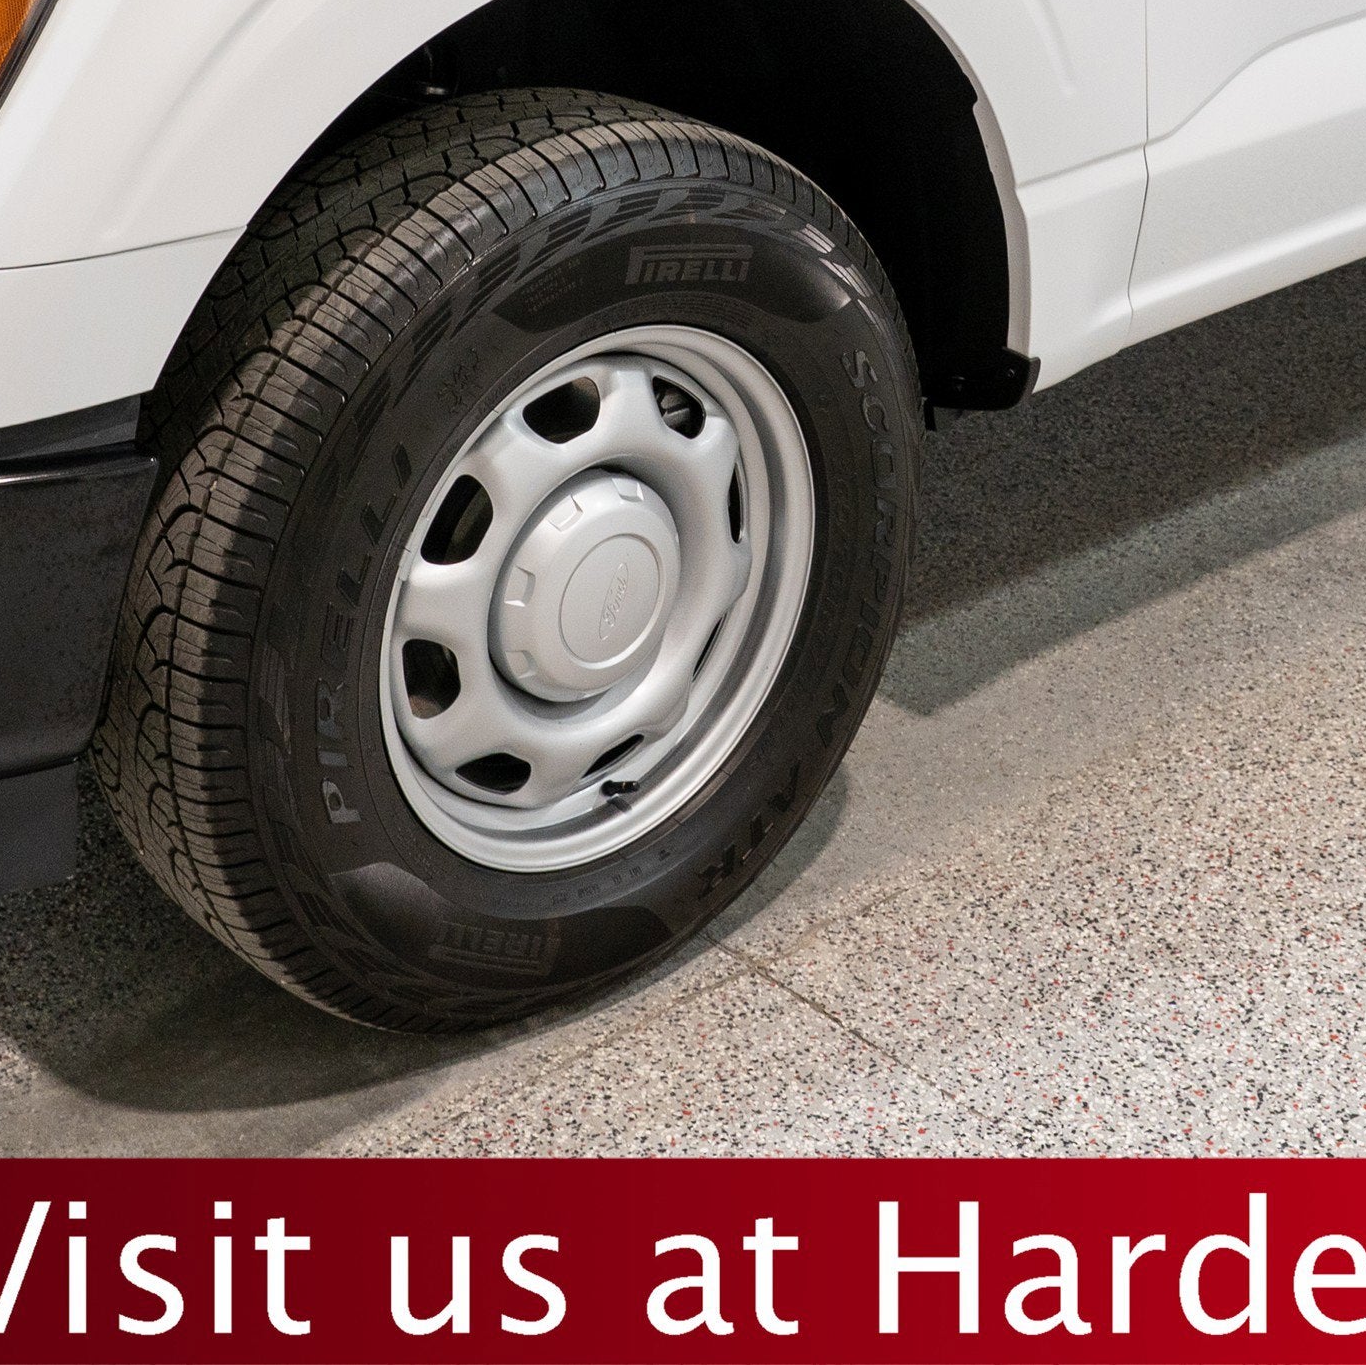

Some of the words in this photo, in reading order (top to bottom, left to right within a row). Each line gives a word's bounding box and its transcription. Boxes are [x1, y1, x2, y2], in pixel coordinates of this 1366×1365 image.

[624, 244, 754, 285] PIRELLI
[316, 440, 413, 825] PIRELLI
[817, 347, 897, 749] SCORPION
